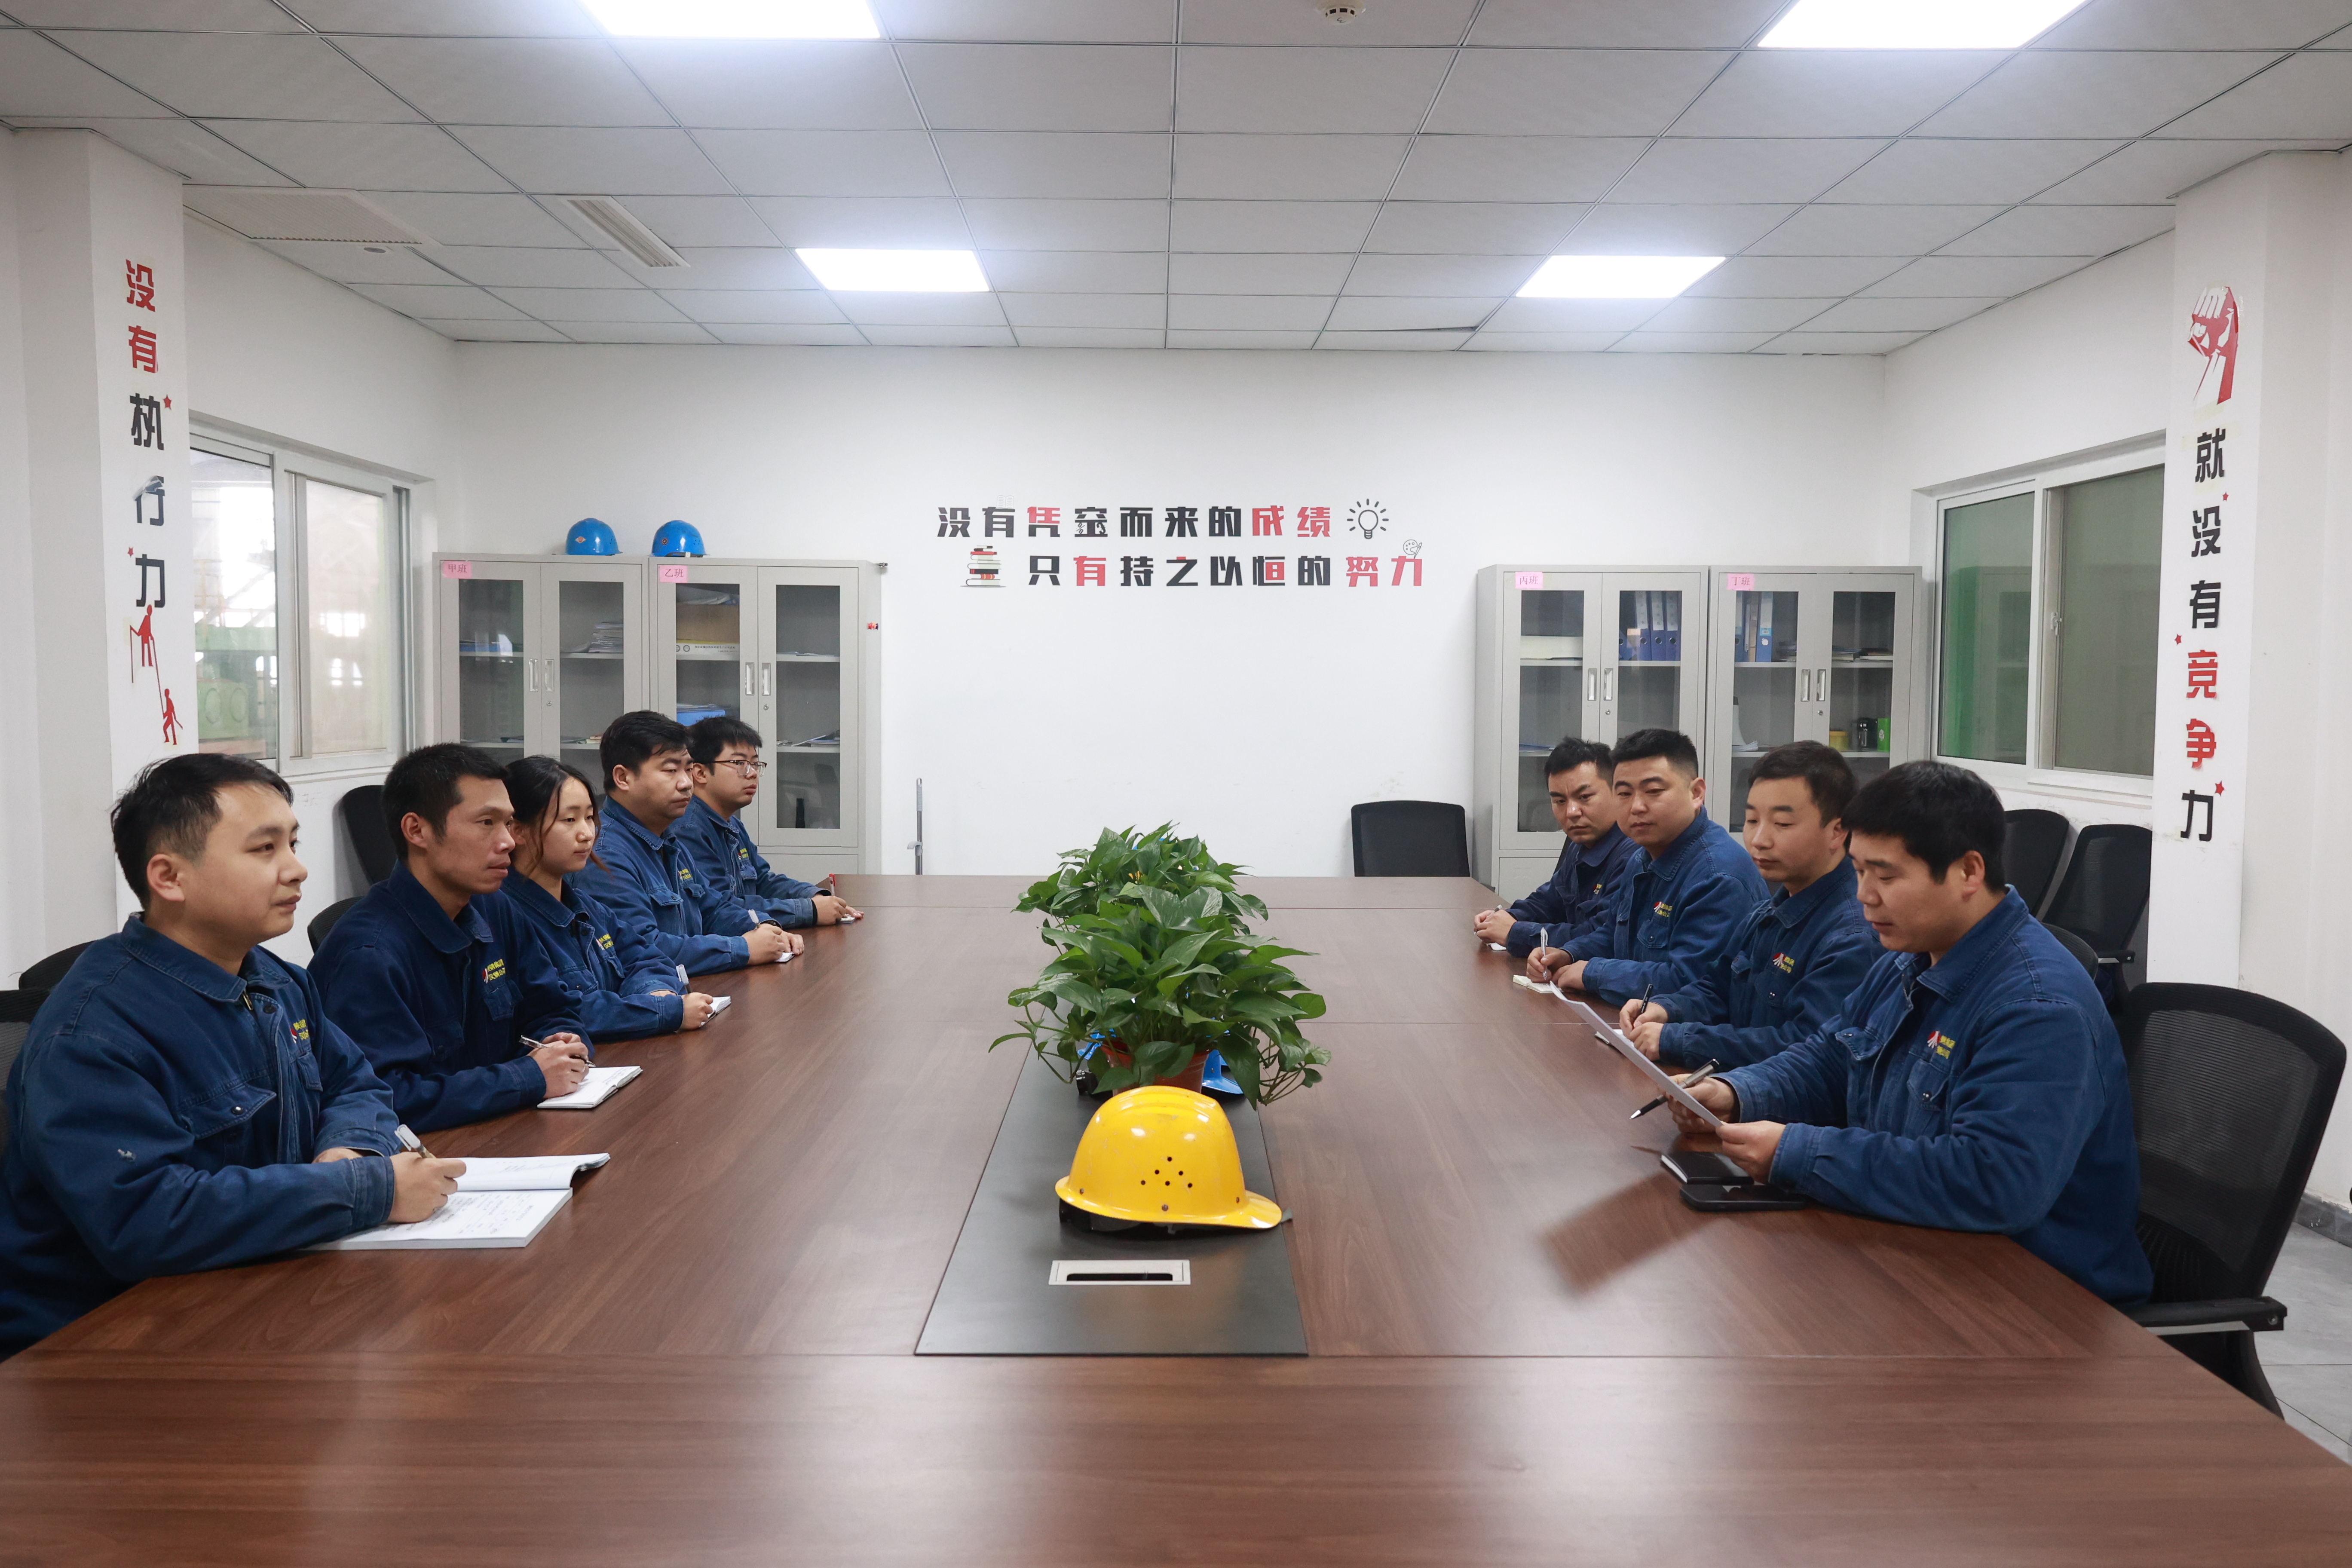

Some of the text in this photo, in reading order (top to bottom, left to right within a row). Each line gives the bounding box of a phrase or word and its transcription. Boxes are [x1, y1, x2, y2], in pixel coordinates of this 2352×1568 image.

[937, 505, 1331, 538] 没有凭空而来的成绩
[448, 564, 467, 573] 甲班
[665, 568, 684, 578] 乙班
[1028, 555, 1423, 587] 只有持之以恒的努力
[1520, 576, 1538, 585] 丙班
[1732, 577, 1750, 585] 丁班
[2180, 428, 2226, 842] 就没有竞争力
